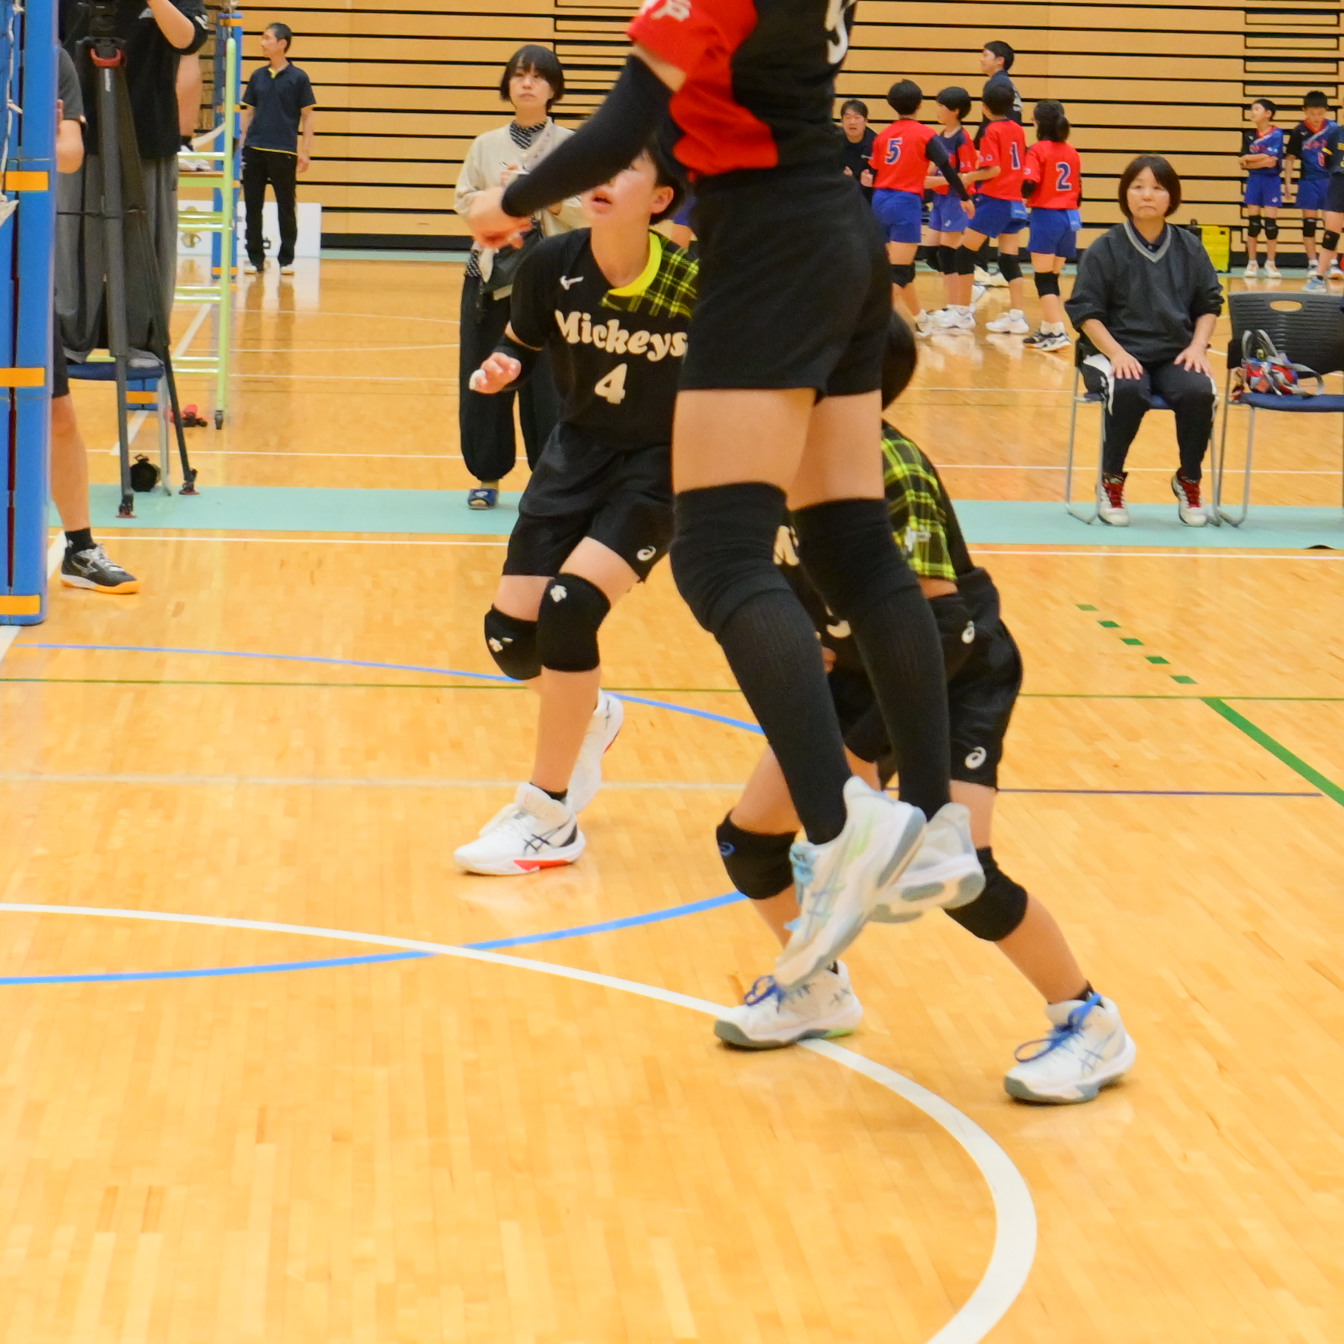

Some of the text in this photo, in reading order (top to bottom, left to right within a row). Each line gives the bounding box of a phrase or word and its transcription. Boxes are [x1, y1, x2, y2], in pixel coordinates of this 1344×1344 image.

[885, 136, 903, 165] 5
[1011, 142, 1020, 170] 1
[1056, 162, 1071, 191] 2
[554, 309, 689, 362] Mickeys
[594, 362, 628, 404] 4
